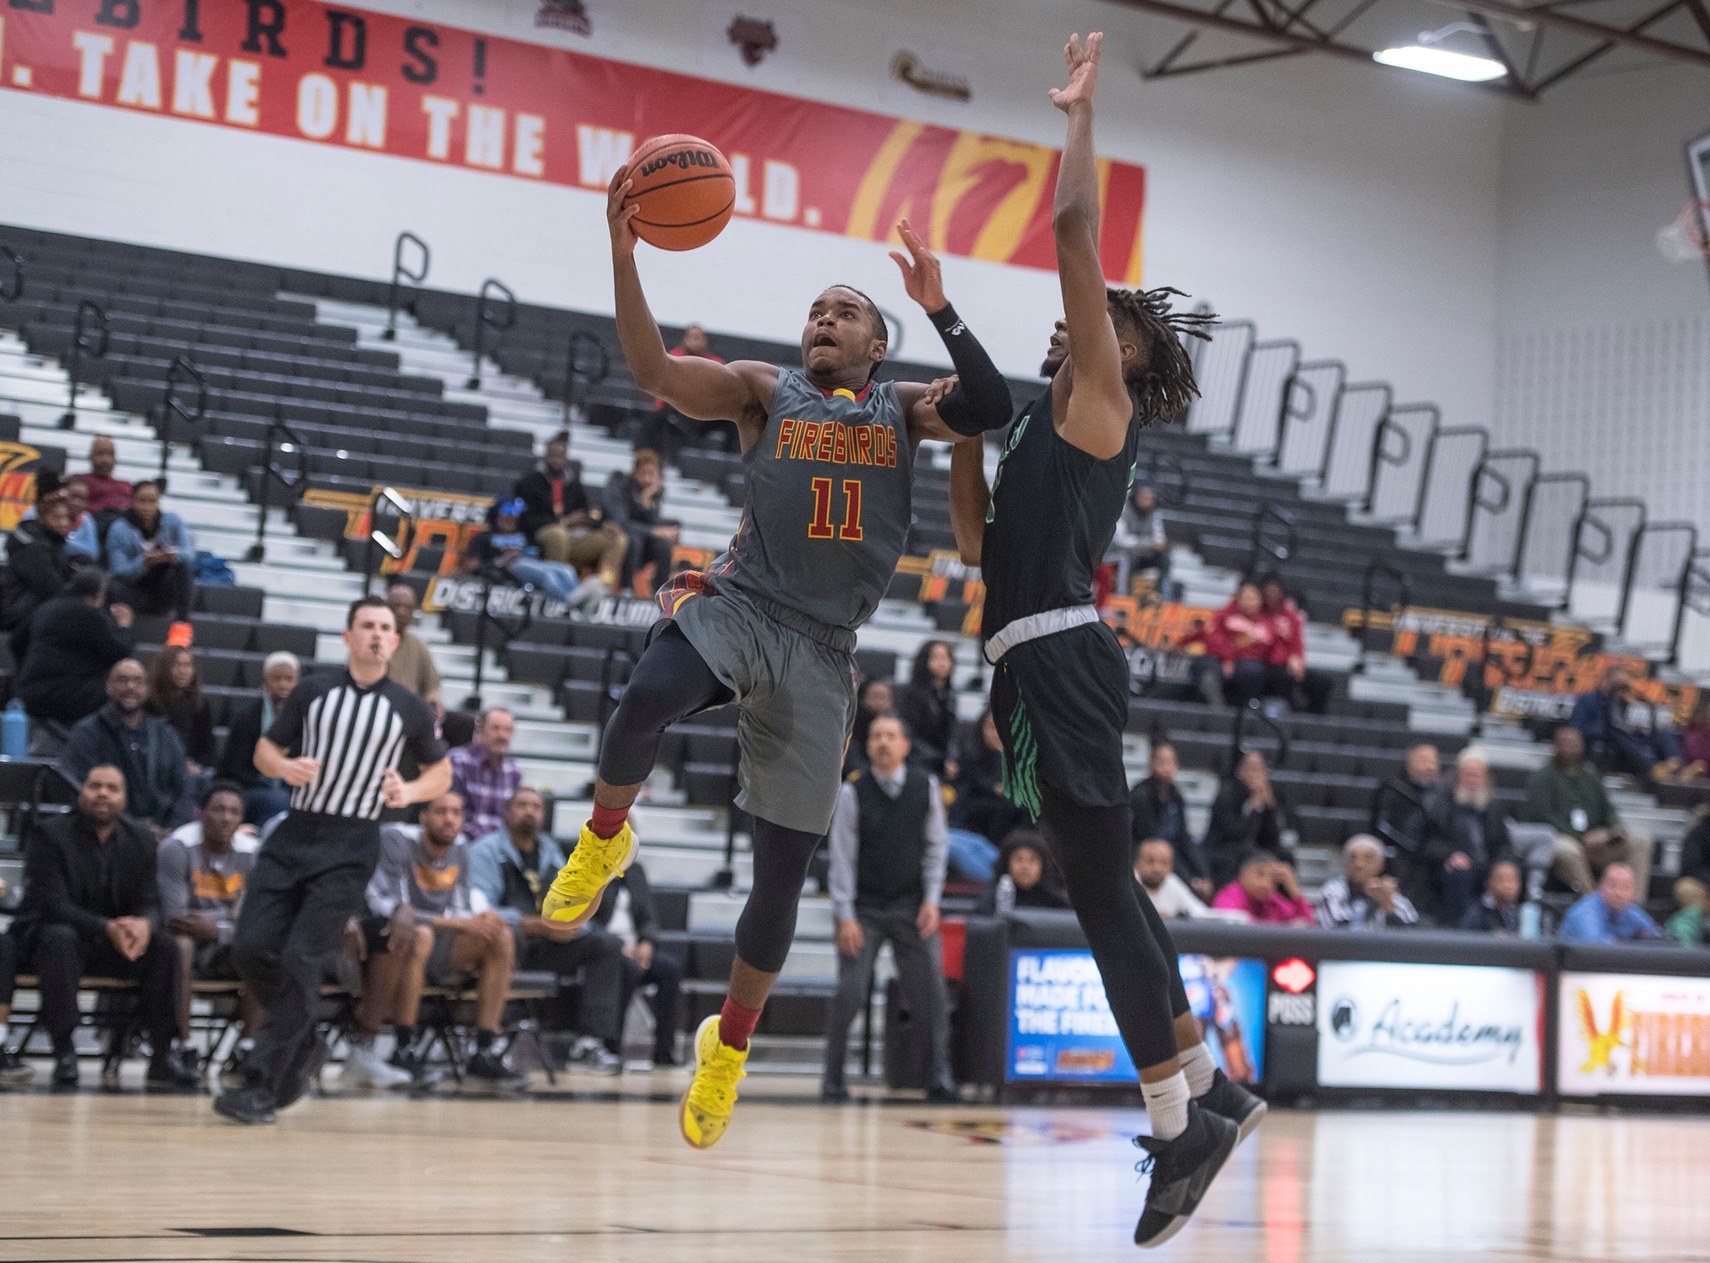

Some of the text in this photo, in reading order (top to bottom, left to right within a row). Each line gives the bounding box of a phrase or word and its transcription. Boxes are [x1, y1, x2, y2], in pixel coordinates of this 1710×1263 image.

[73, 30, 262, 127] TAKE
[297, 72, 389, 149] ON
[422, 94, 546, 177] THE
[576, 123, 822, 227] WLD.
[640, 150, 719, 177] Wilson
[775, 418, 897, 468] FIREBIRDS
[807, 476, 863, 541] 11
[1371, 997, 1523, 1063] Academy
